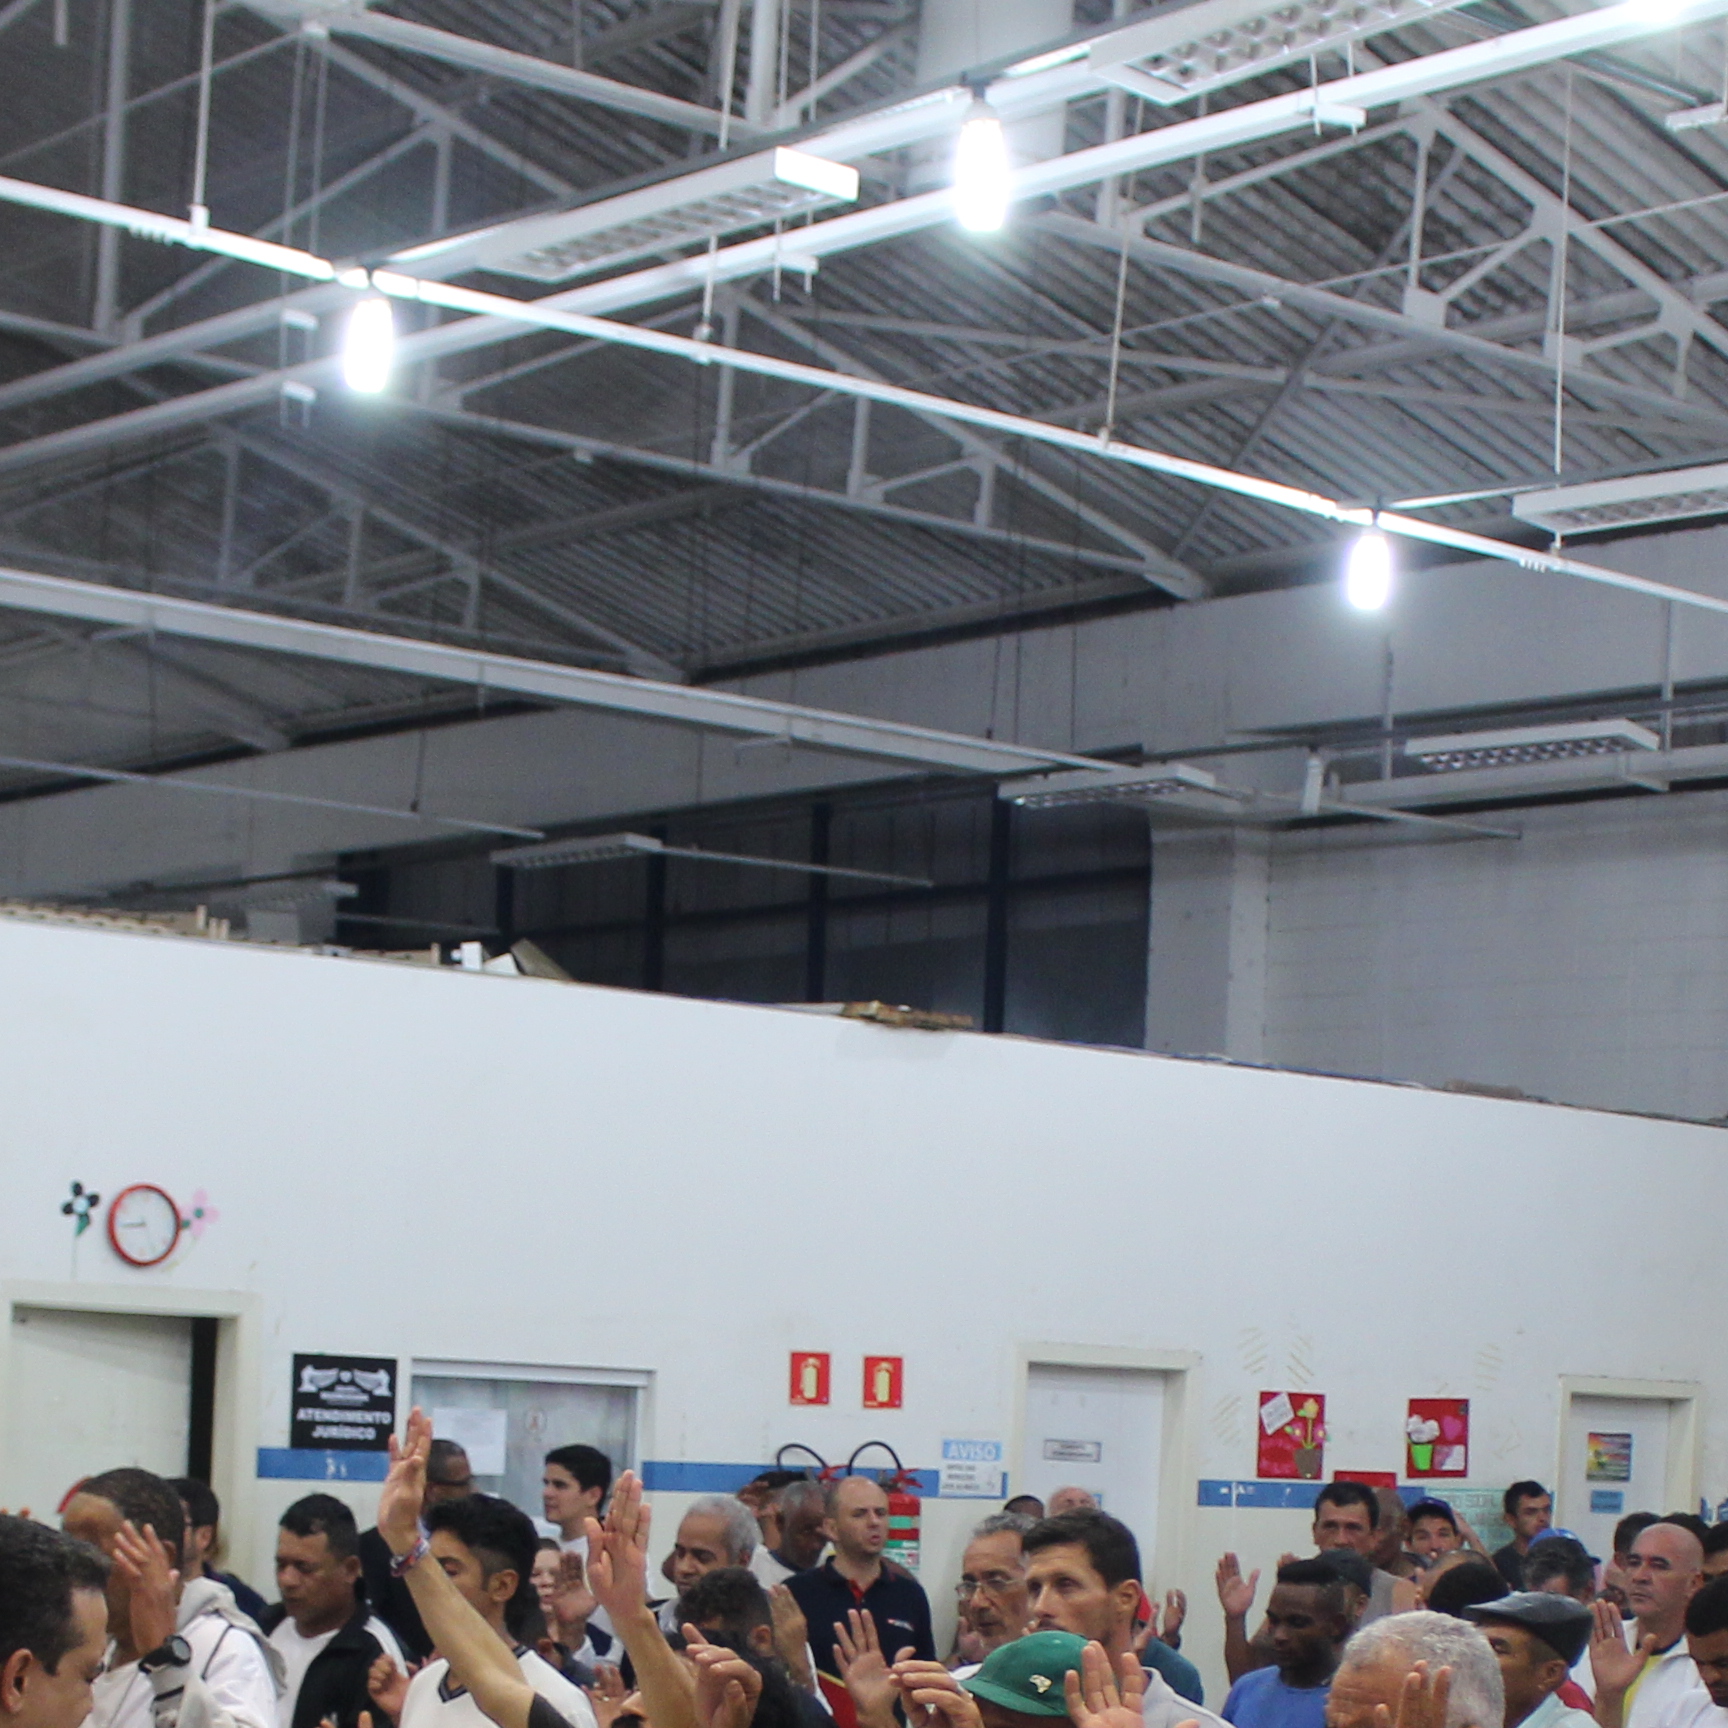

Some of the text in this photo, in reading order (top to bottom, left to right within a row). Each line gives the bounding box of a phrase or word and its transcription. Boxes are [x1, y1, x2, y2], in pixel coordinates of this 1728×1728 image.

[296, 1407, 392, 1425] ATENDIMENTO
[311, 1424, 377, 1441] JURÍDICO
[948, 1441, 997, 1461] AVISO
